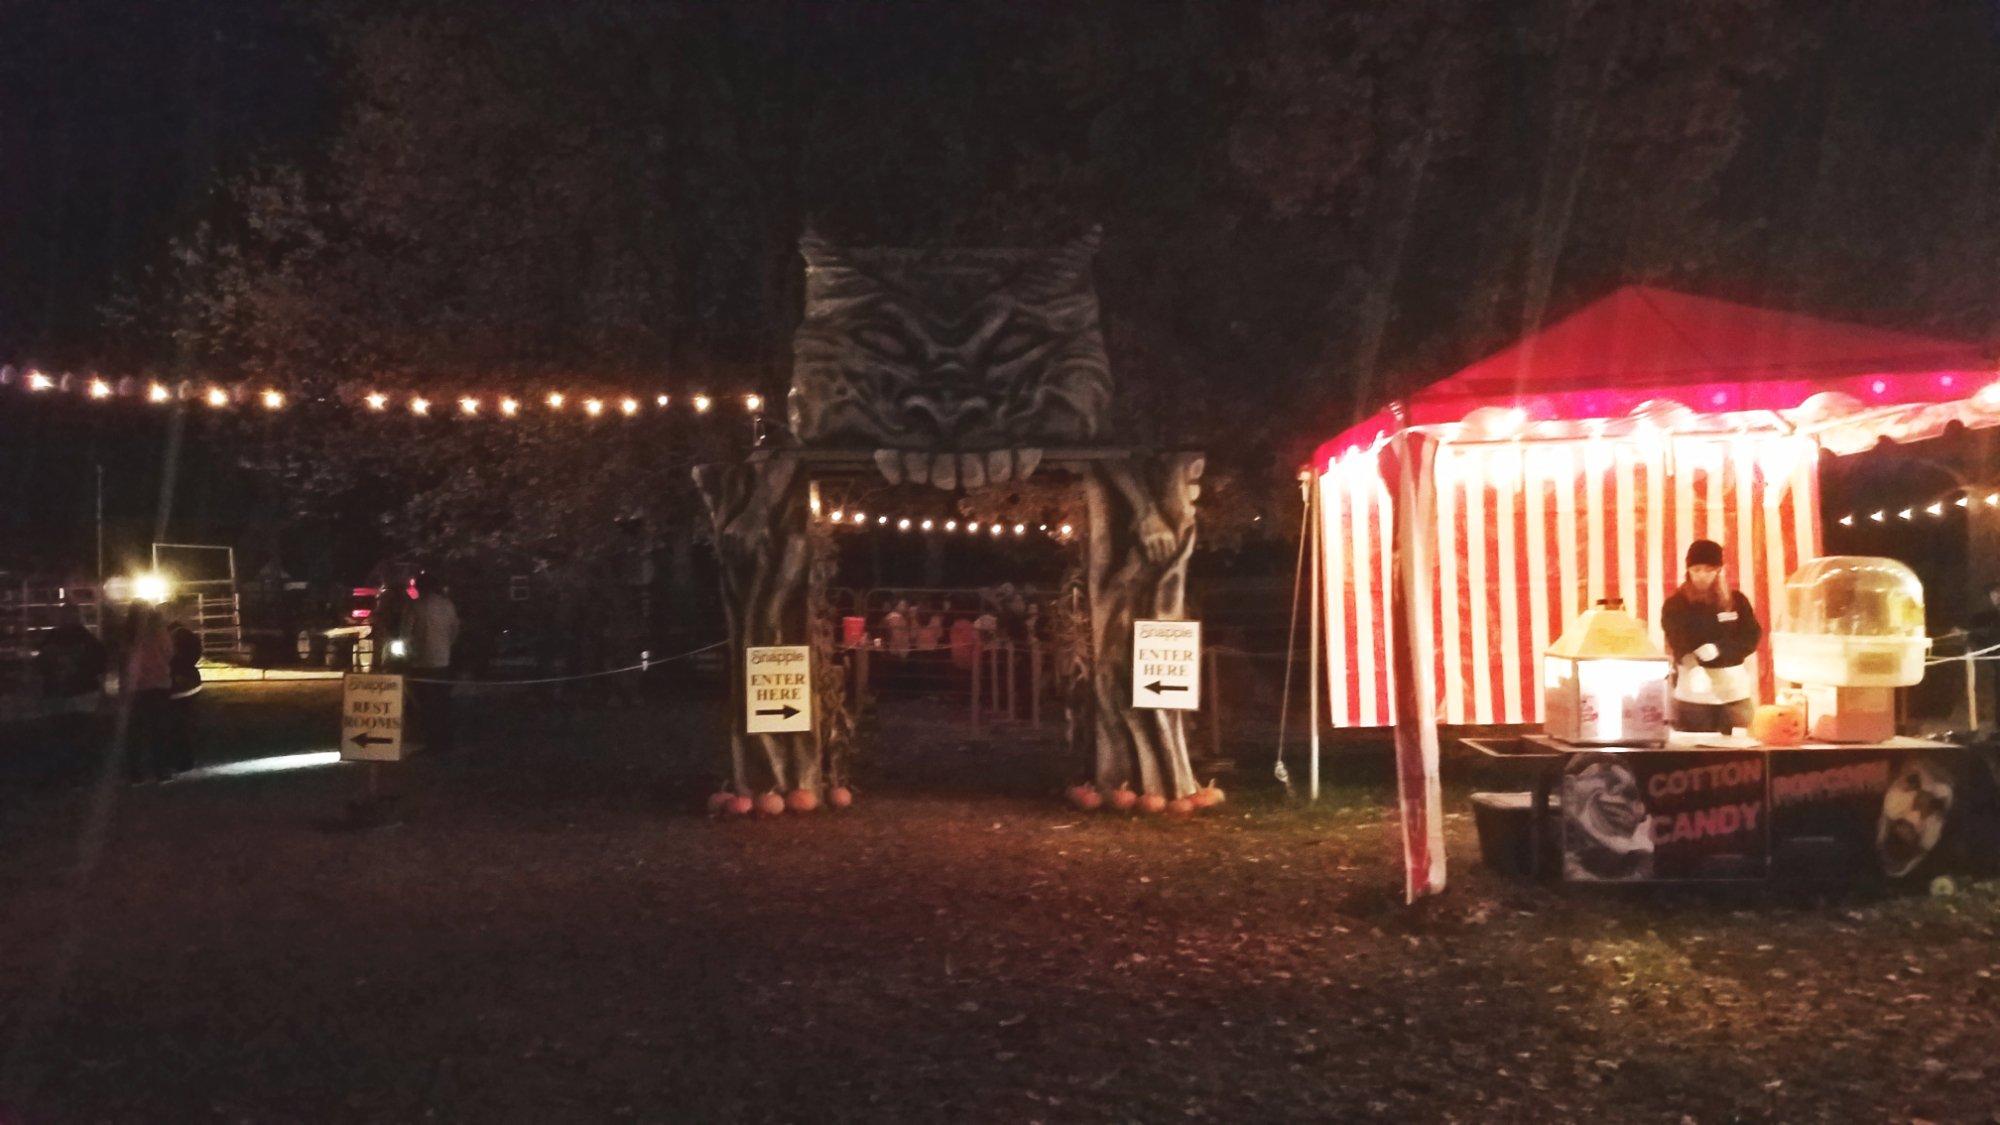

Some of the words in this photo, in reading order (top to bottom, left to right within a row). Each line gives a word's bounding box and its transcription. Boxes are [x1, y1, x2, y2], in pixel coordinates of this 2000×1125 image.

[1138, 648, 1194, 661] ENTER
[1143, 664, 1188, 676] HERE
[751, 673, 805, 686] ENTER
[757, 688, 802, 700] HERE
[352, 702, 392, 715] REST
[1649, 757, 1762, 797] COTTON
[1653, 801, 1761, 846] CANDY
